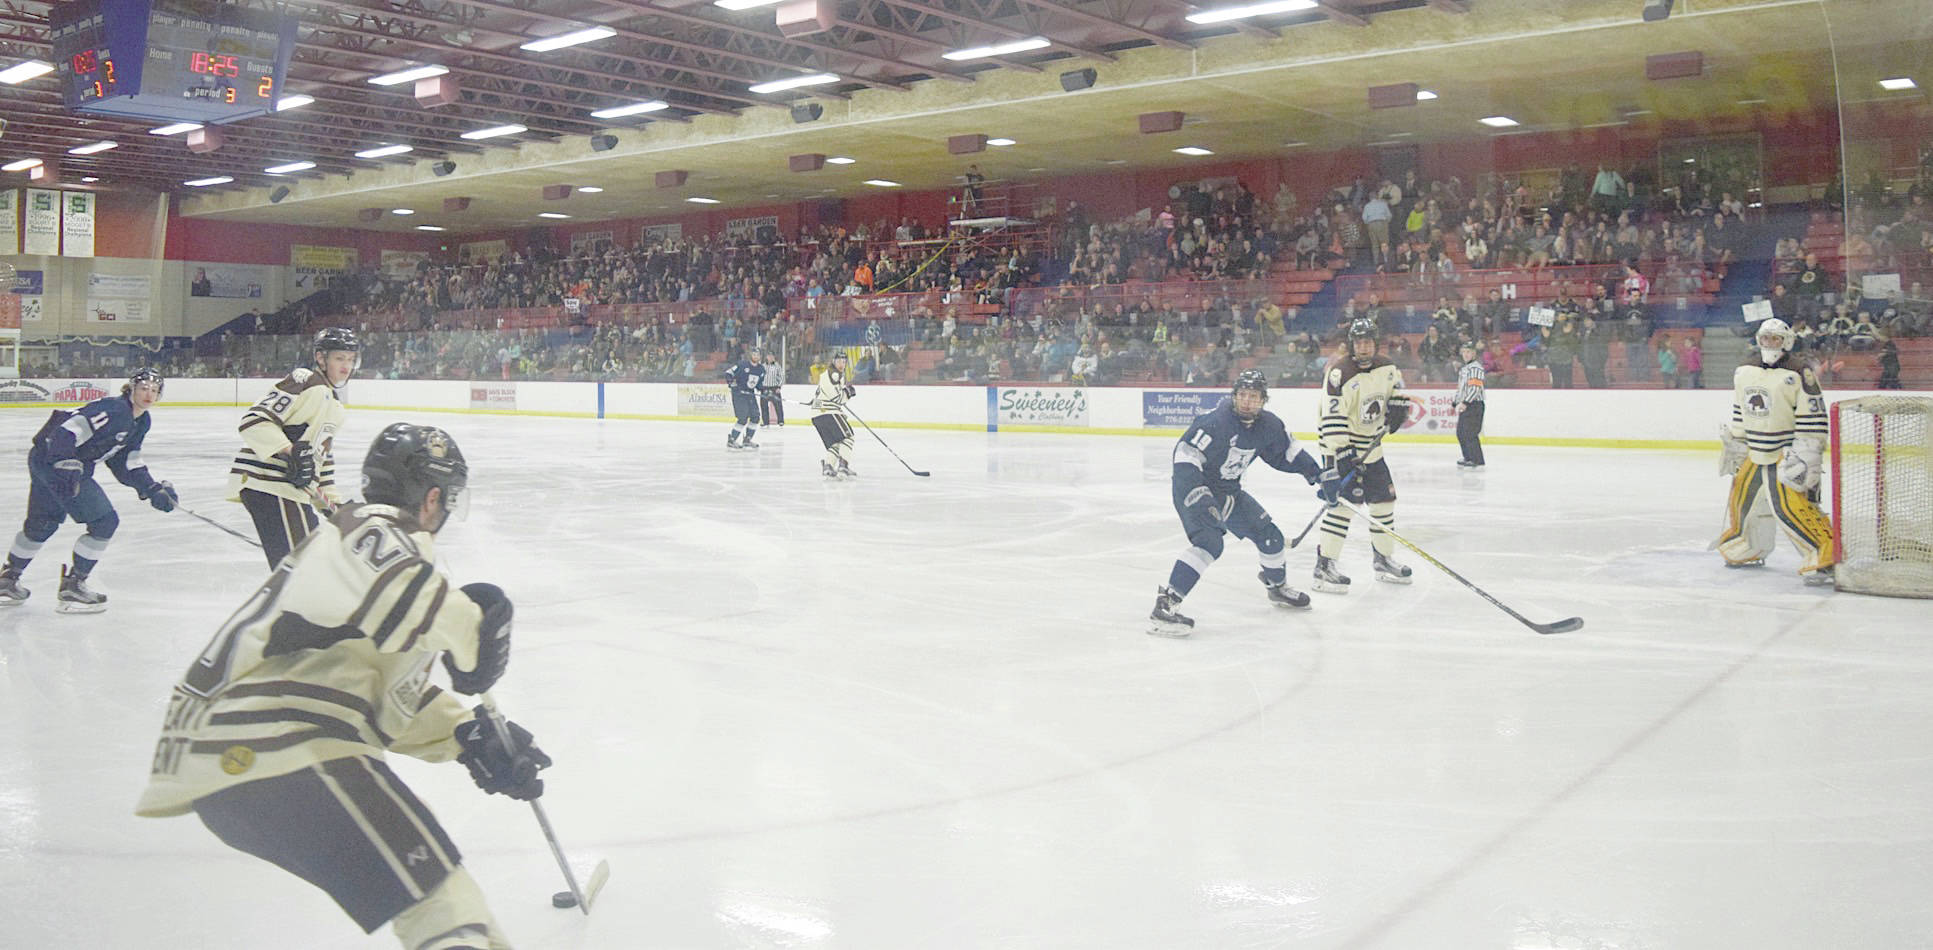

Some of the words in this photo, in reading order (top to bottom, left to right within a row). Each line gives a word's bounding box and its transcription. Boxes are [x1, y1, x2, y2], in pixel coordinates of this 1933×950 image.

[152, 14, 177, 25] player
[181, 19, 212, 32] penalty
[221, 24, 250, 37] penalty
[149, 48, 173, 60] Home
[191, 51, 239, 78] 18:25
[194, 87, 221, 98] period
[258, 76, 273, 98] 2
[225, 87, 236, 104] 3
[1502, 284, 1516, 299] H
[807, 298, 817, 309] K
[942, 293, 951, 305] J
[669, 313, 676, 324] L
[54, 387, 77, 401] PAPA
[1157, 394, 1173, 403] Your
[1174, 393, 1201, 405] Friendly
[260, 391, 292, 414] 28
[1000, 389, 1087, 418] Sweeney's
[1329, 398, 1339, 414] 2
[1147, 404, 1193, 416] Neighborhood
